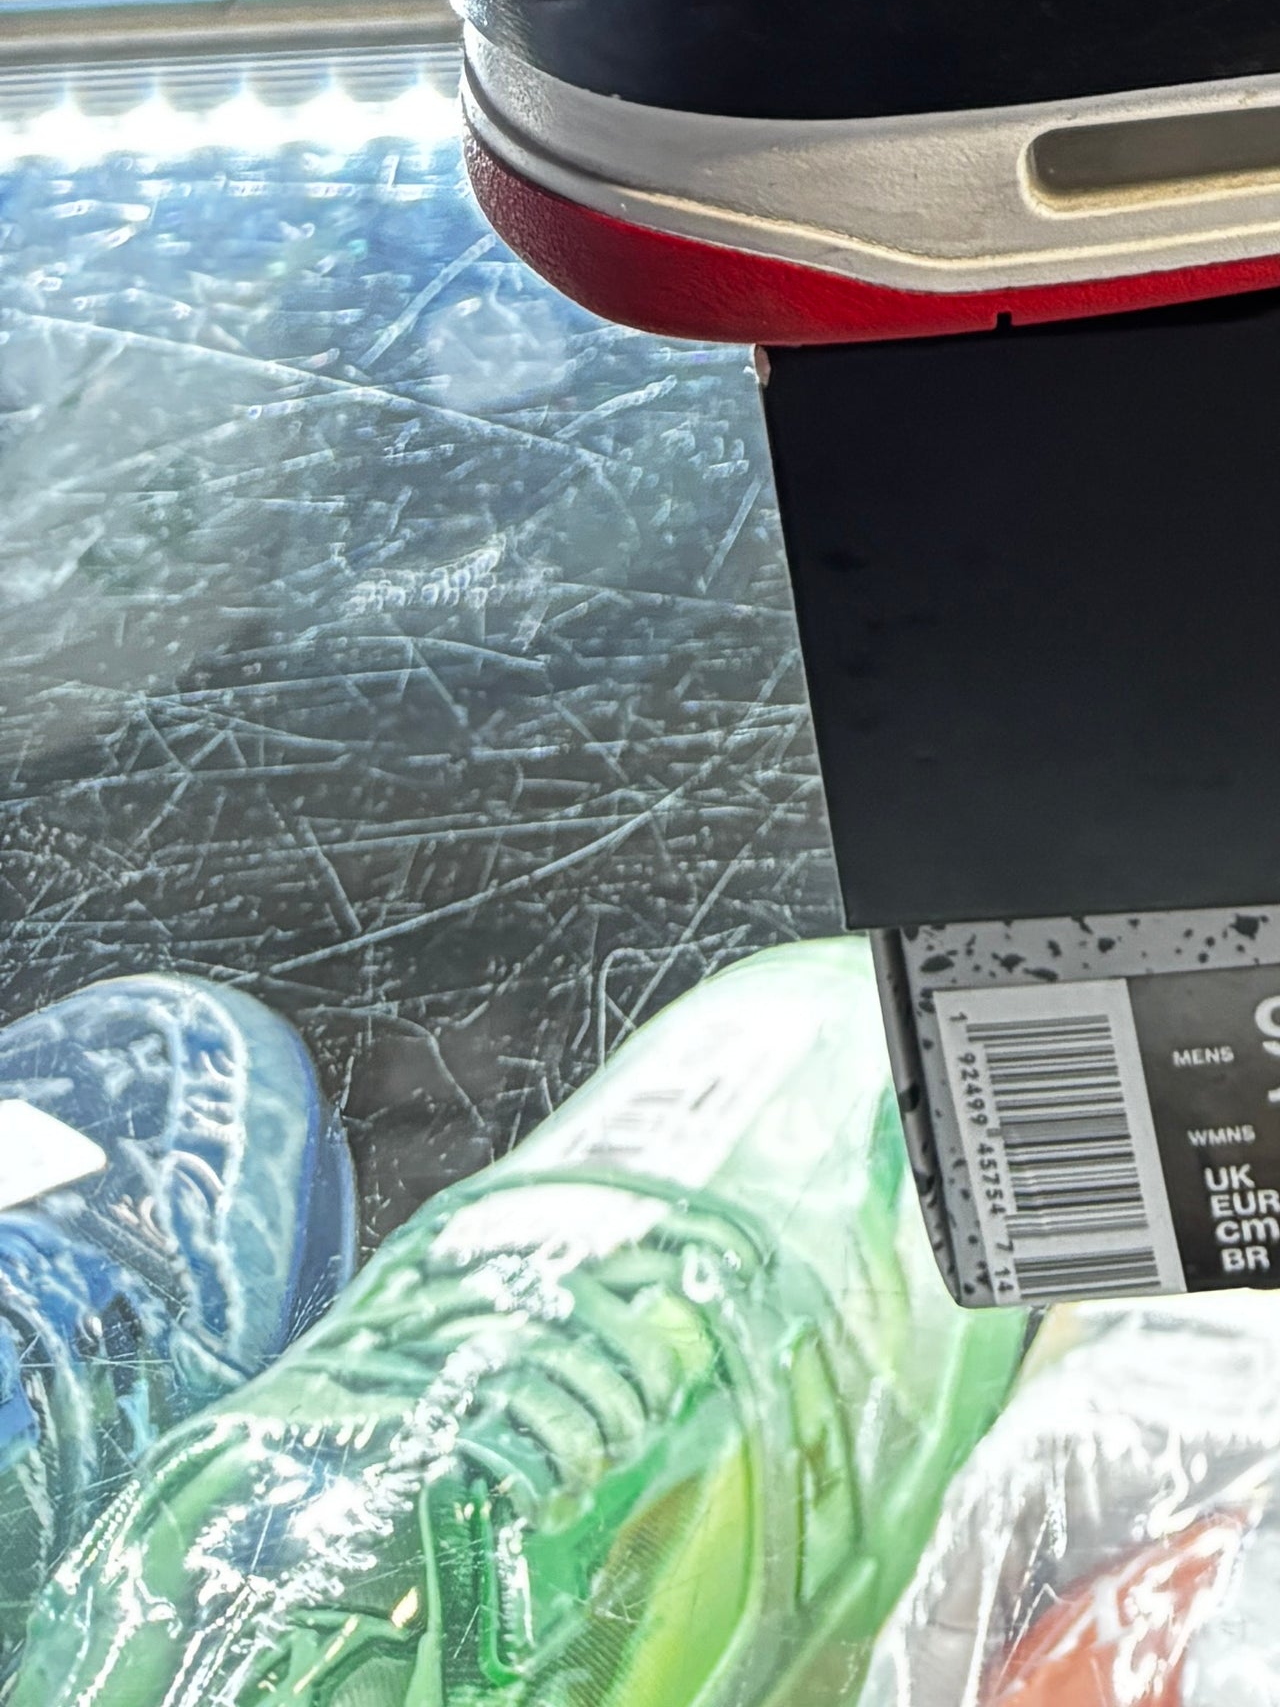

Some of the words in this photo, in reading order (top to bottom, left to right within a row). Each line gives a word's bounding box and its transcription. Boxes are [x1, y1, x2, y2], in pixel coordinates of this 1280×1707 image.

[1172, 1045, 1235, 1068] MENS
[957, 1052, 988, 1126] 92499
[978, 1142, 1007, 1215] 45754
[1187, 1124, 1256, 1147] WMNS
[1204, 1163, 1255, 1191] UK
[1215, 1217, 1280, 1243] cm
[1221, 1246, 1270, 1272] BR
